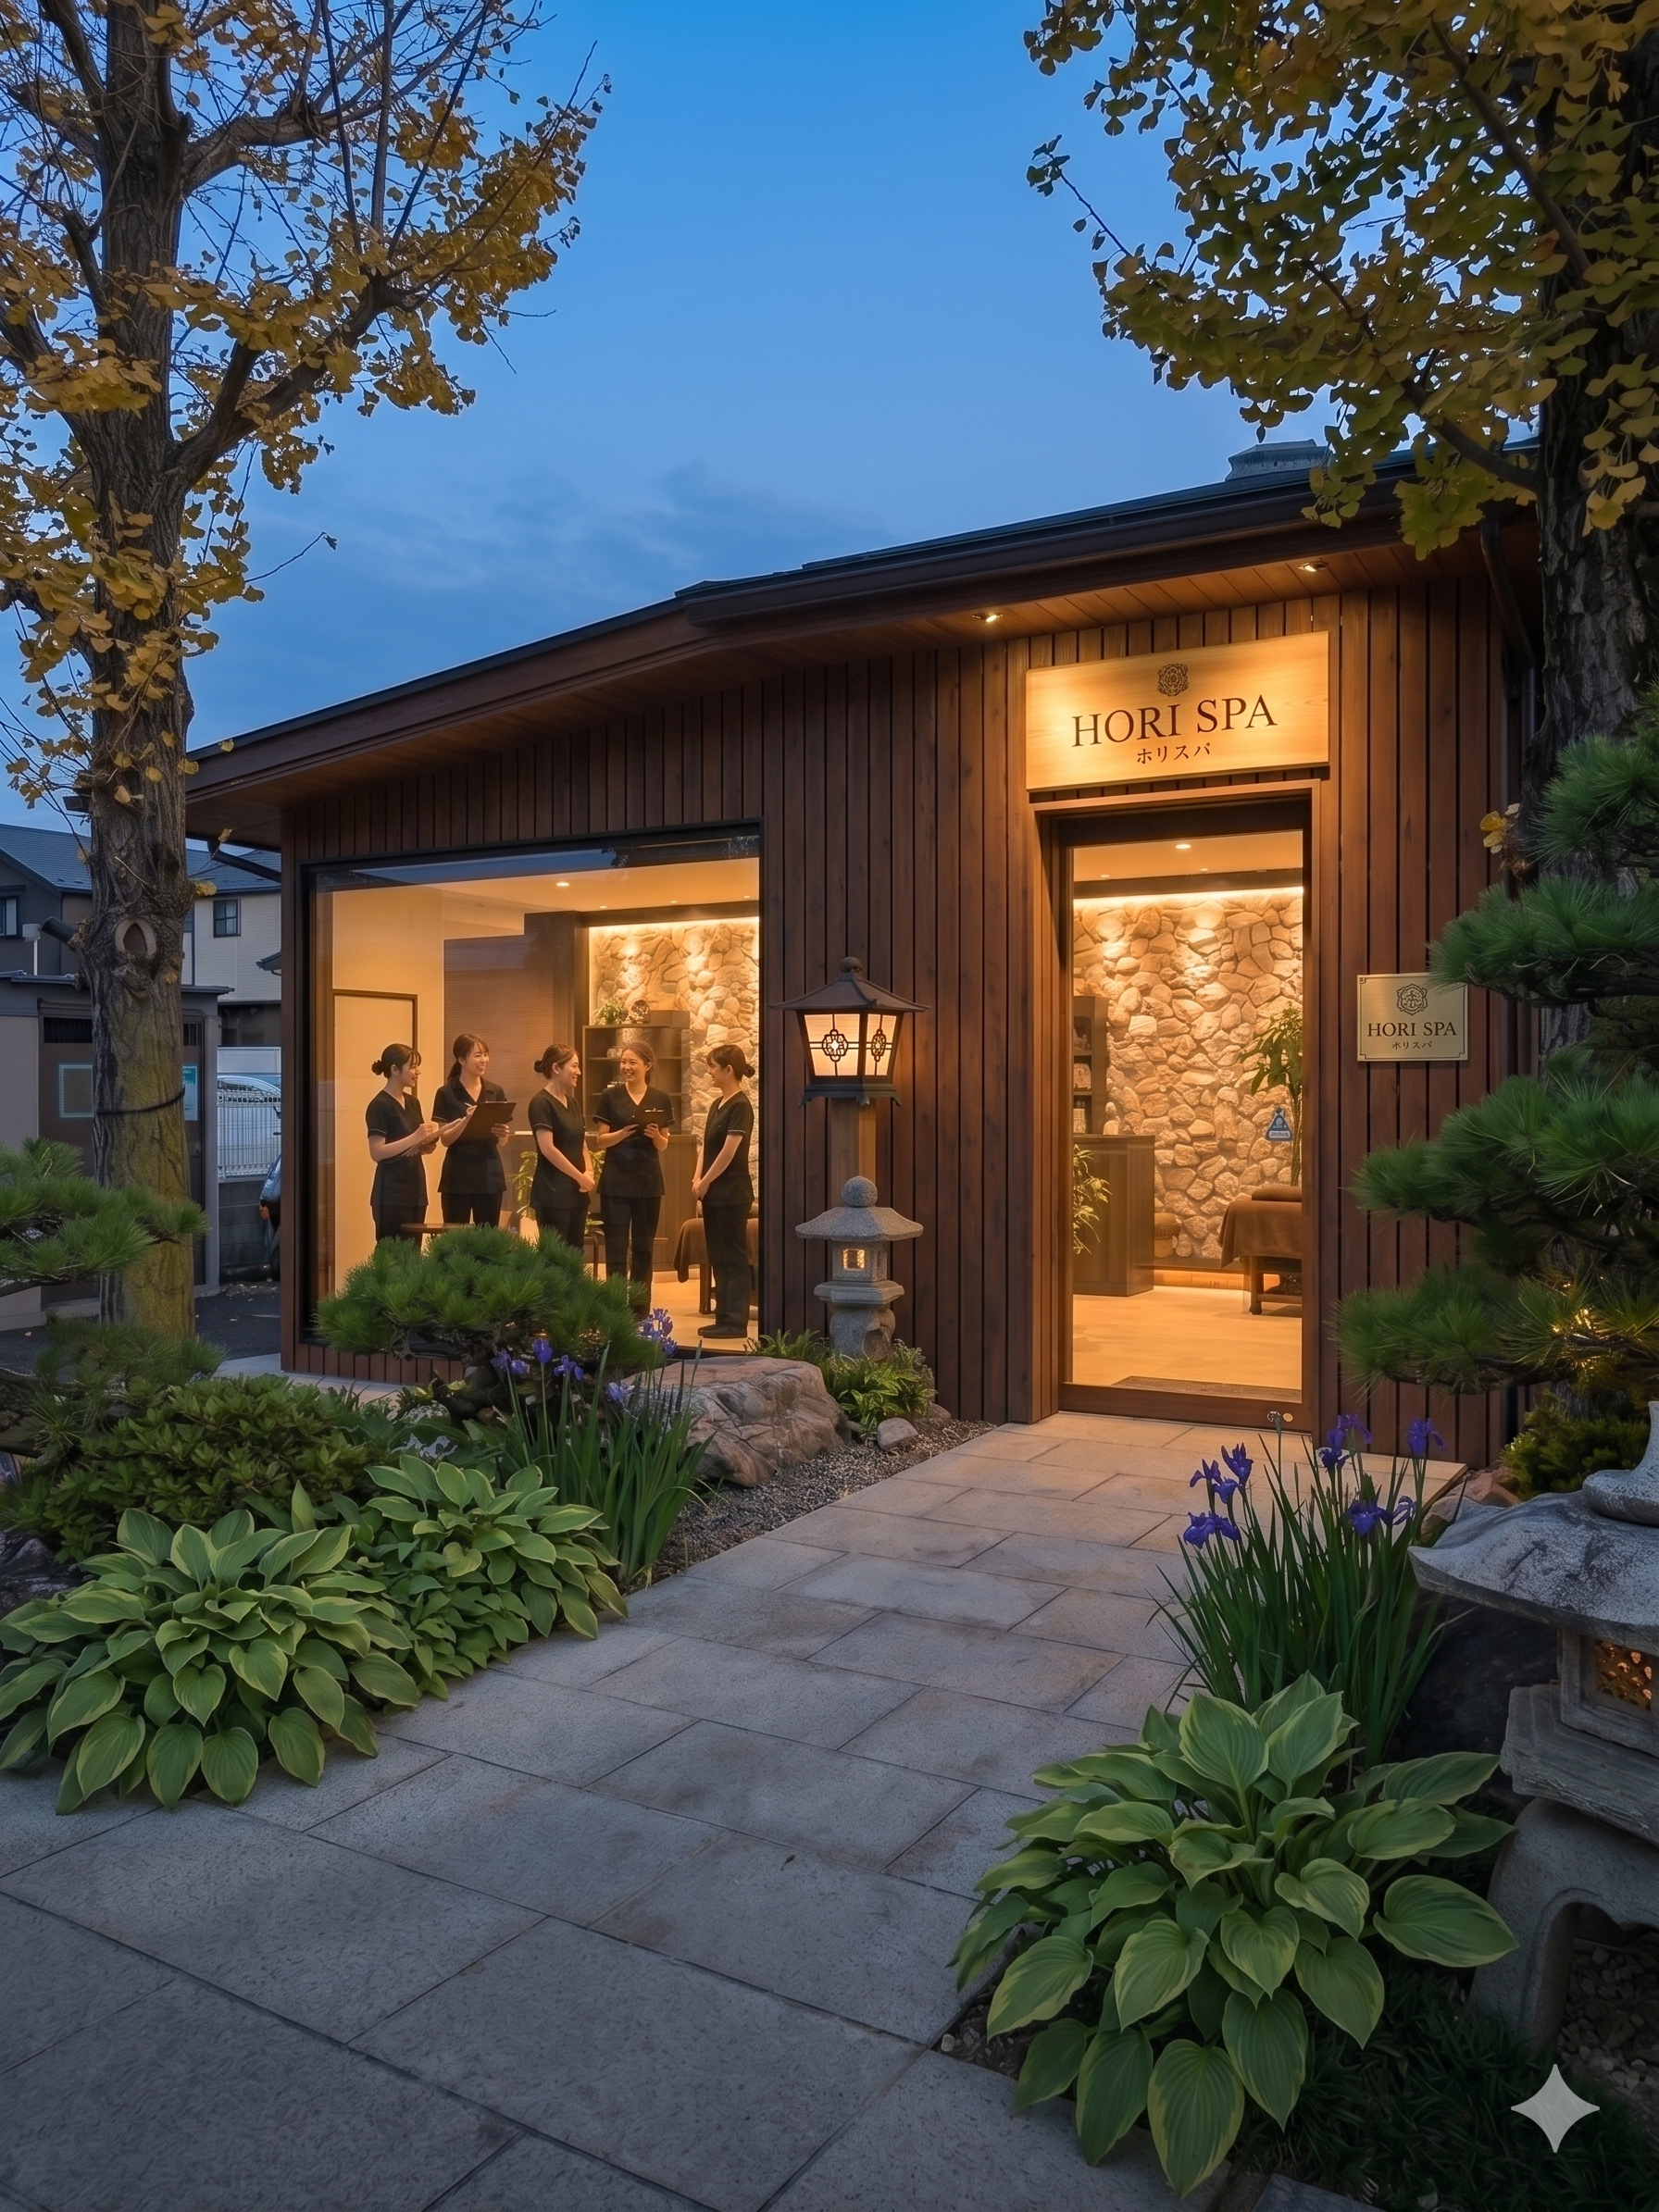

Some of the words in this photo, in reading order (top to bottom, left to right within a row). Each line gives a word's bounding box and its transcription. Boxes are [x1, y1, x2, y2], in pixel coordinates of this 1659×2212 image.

[1071, 703, 1180, 747] HORI
[1197, 694, 1278, 733] SPA
[1137, 742, 1210, 764] ホリスパ
[1367, 1023, 1416, 1037] HORI
[1423, 1022, 1457, 1036] SPA
[1391, 1040, 1432, 1050] ホリスパ
